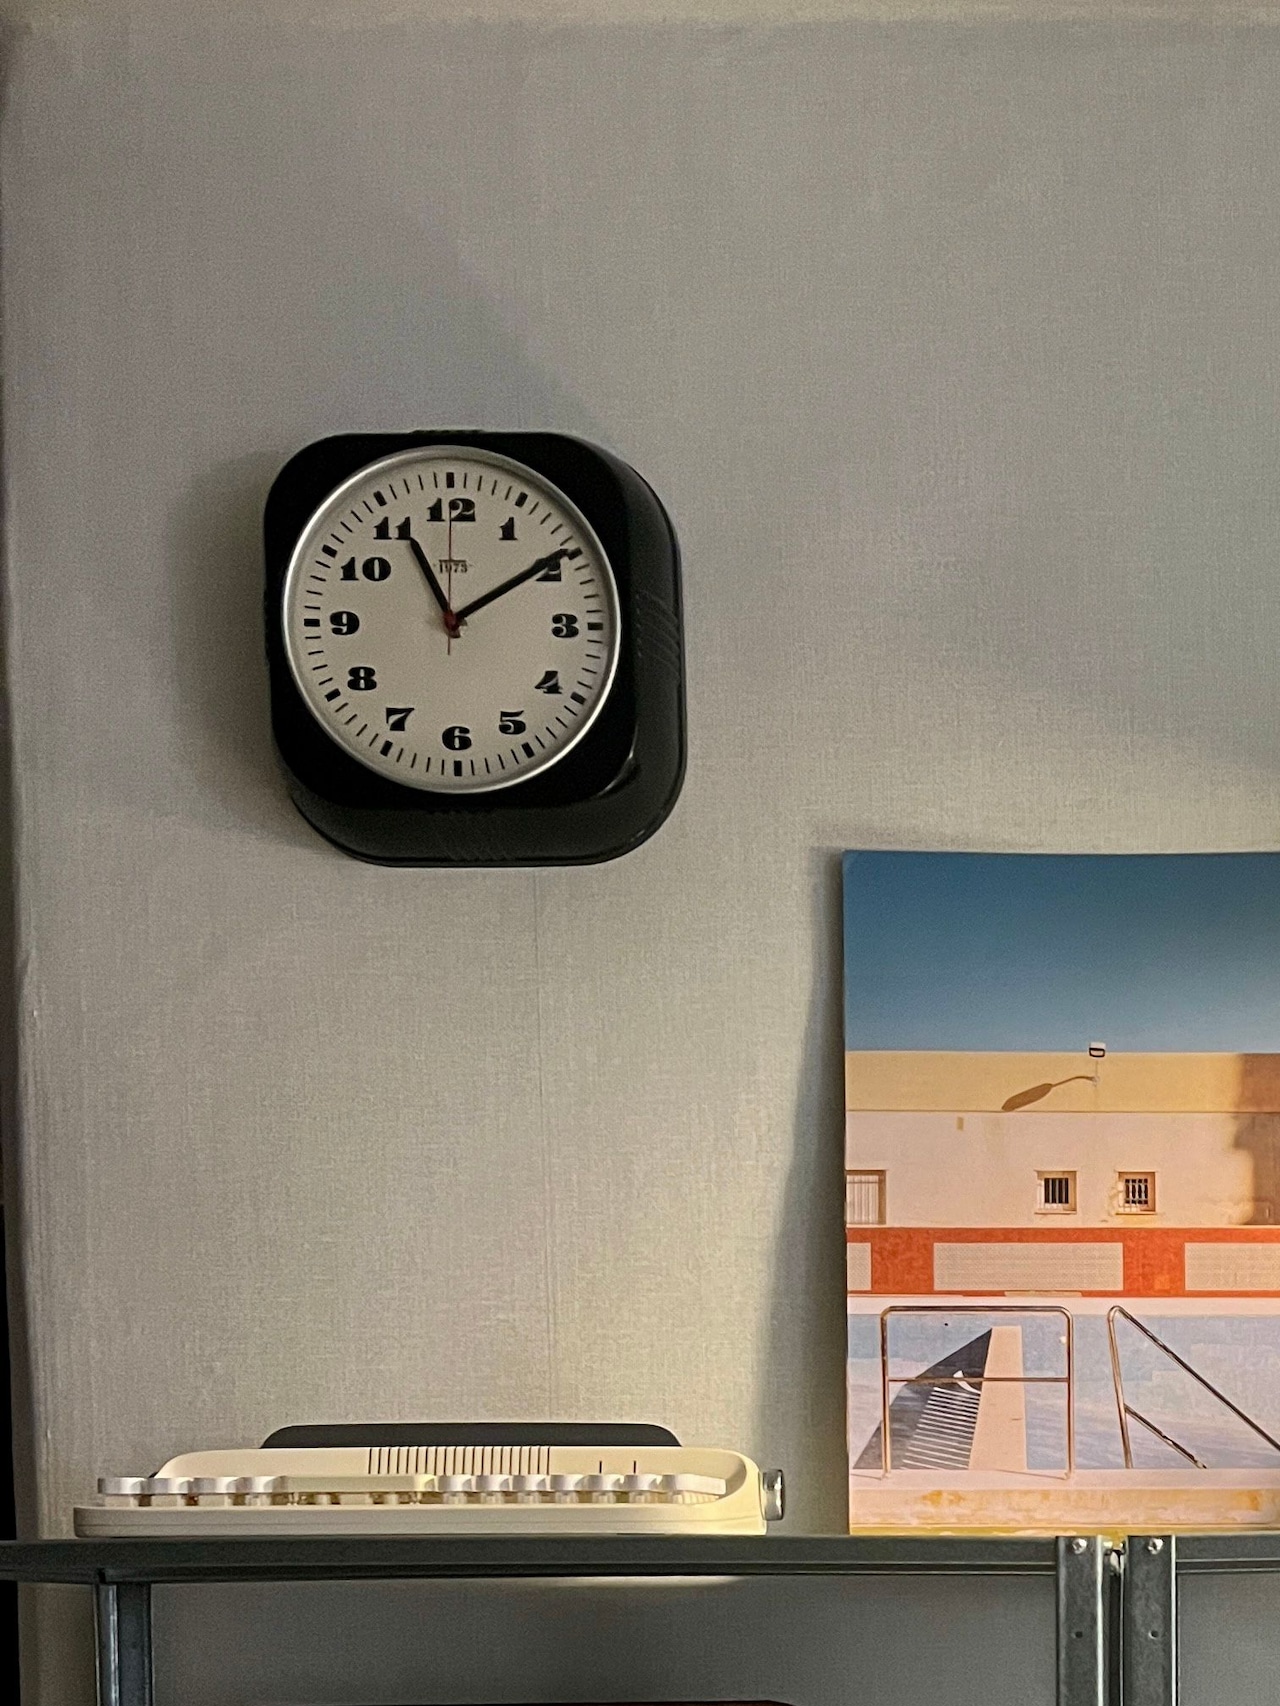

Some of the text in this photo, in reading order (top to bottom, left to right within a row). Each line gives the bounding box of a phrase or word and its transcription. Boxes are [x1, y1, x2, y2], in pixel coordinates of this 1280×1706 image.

[426, 497, 476, 522] 12
[373, 516, 411, 541] 11
[500, 516, 518, 541] 1
[340, 556, 392, 581] 10
[329, 611, 360, 636] 9
[551, 613, 579, 638] 3
[347, 666, 377, 691] 8
[534, 670, 563, 695] 4
[386, 707, 415, 732] 7
[499, 710, 527, 735] 5
[442, 726, 472, 751] 6
